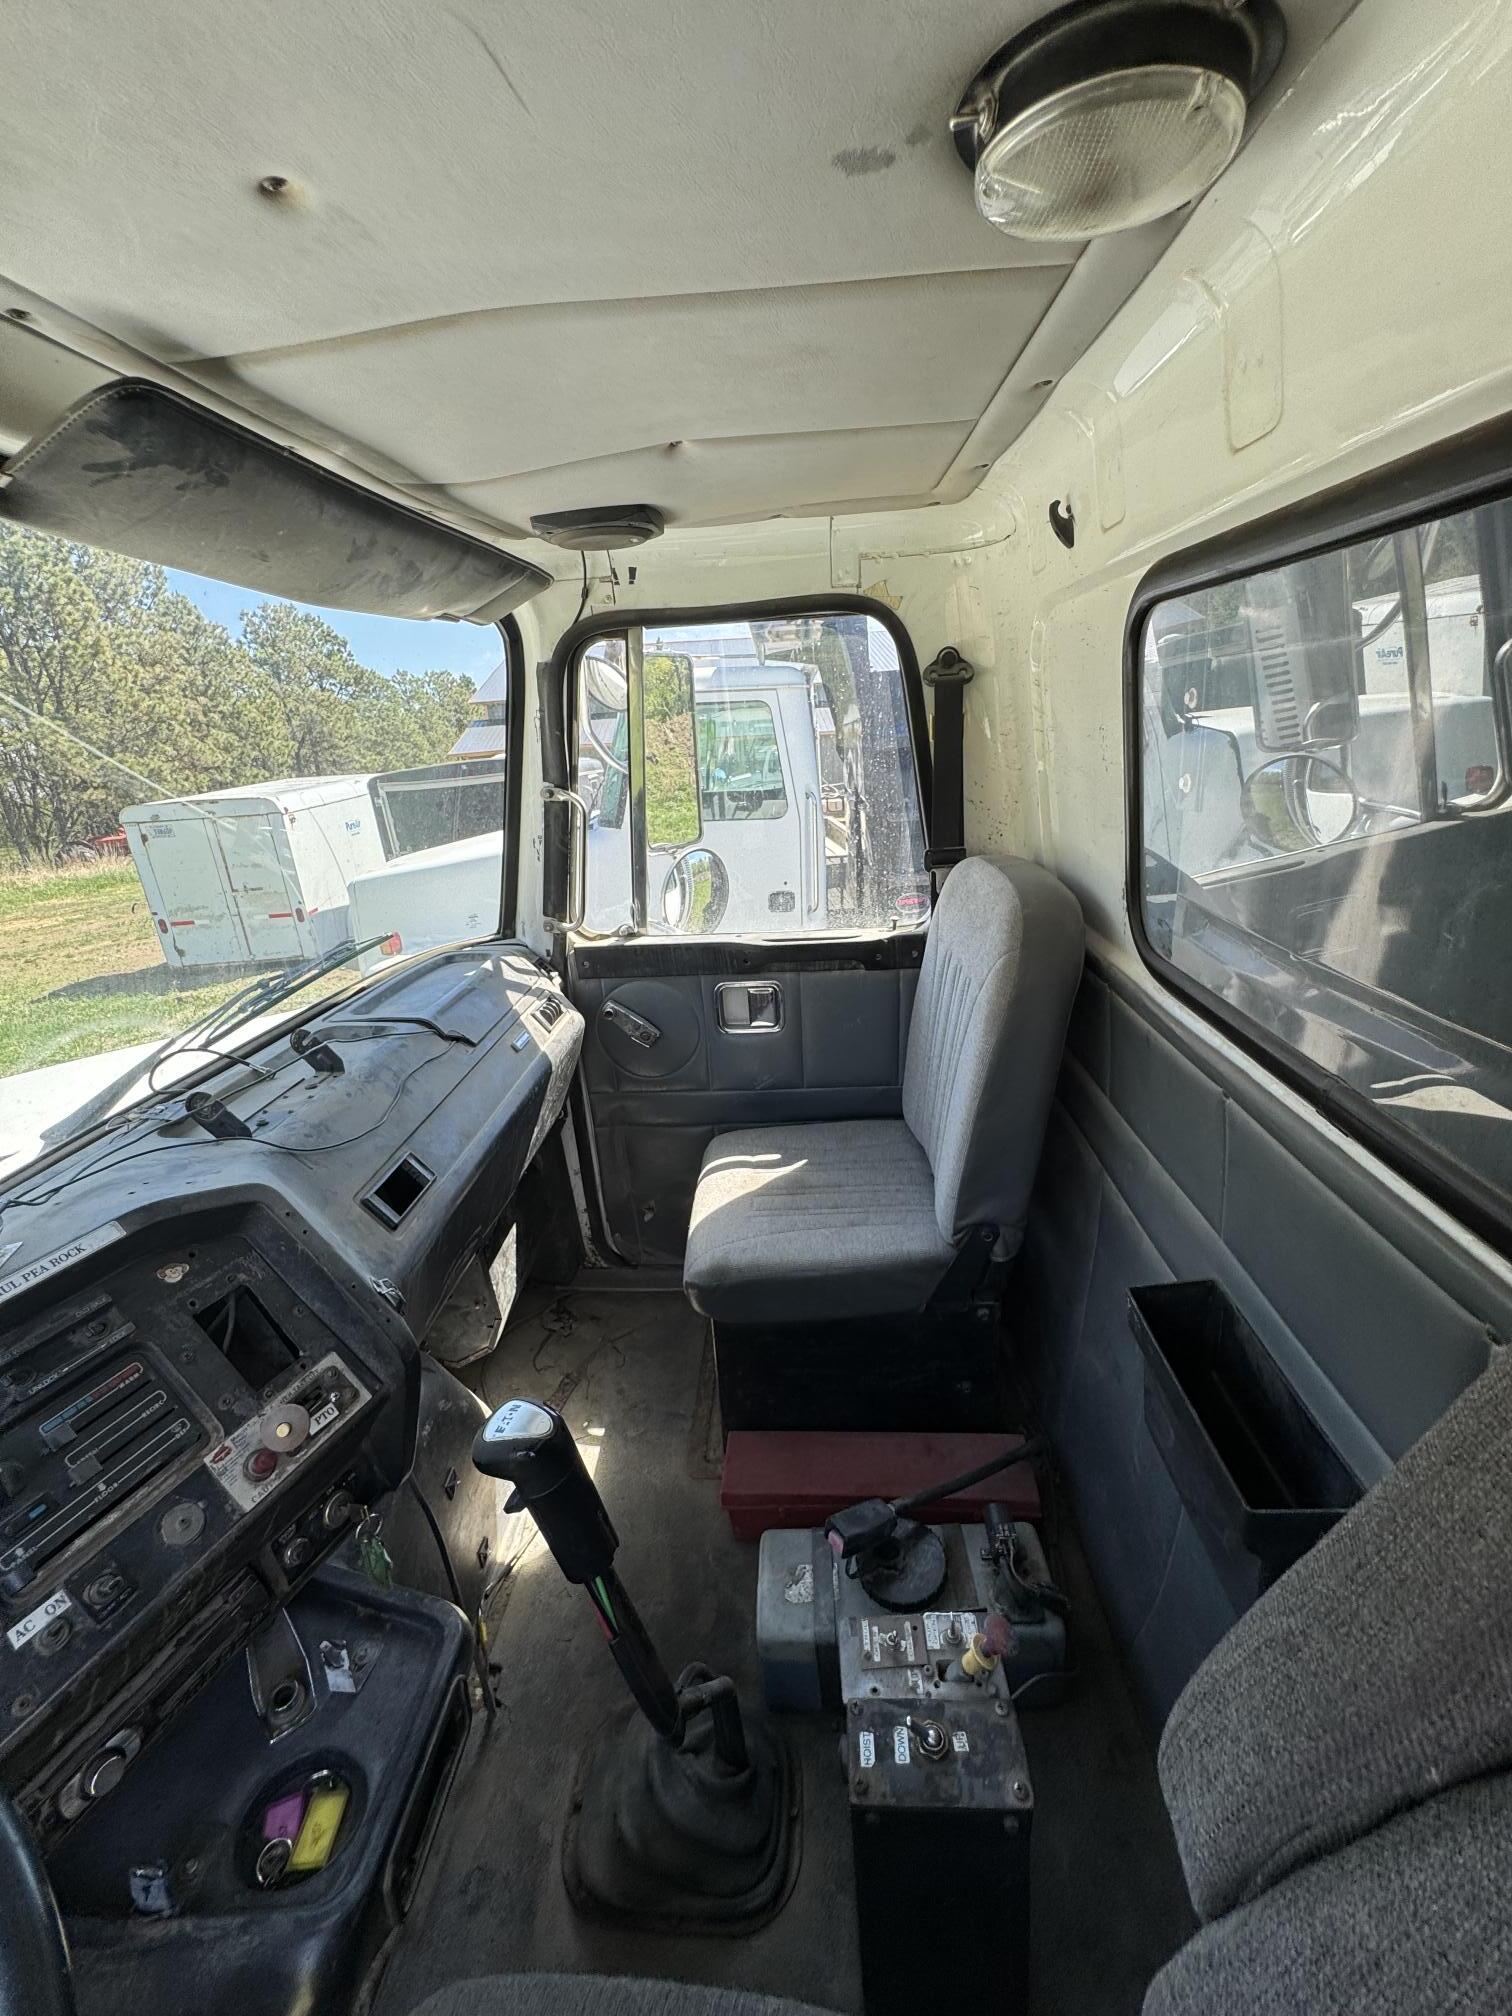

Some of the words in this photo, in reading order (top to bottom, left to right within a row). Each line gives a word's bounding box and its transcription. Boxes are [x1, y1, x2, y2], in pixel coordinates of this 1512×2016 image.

[22, 1264, 49, 1282] PEA
[48, 1242, 86, 1267] ROCK
[314, 1404, 335, 1426] PTO
[15, 1619, 36, 1641] AC
[44, 1593, 68, 1616] ON
[862, 1732, 873, 1766] HOIST
[895, 1726, 907, 1762] DOWN
